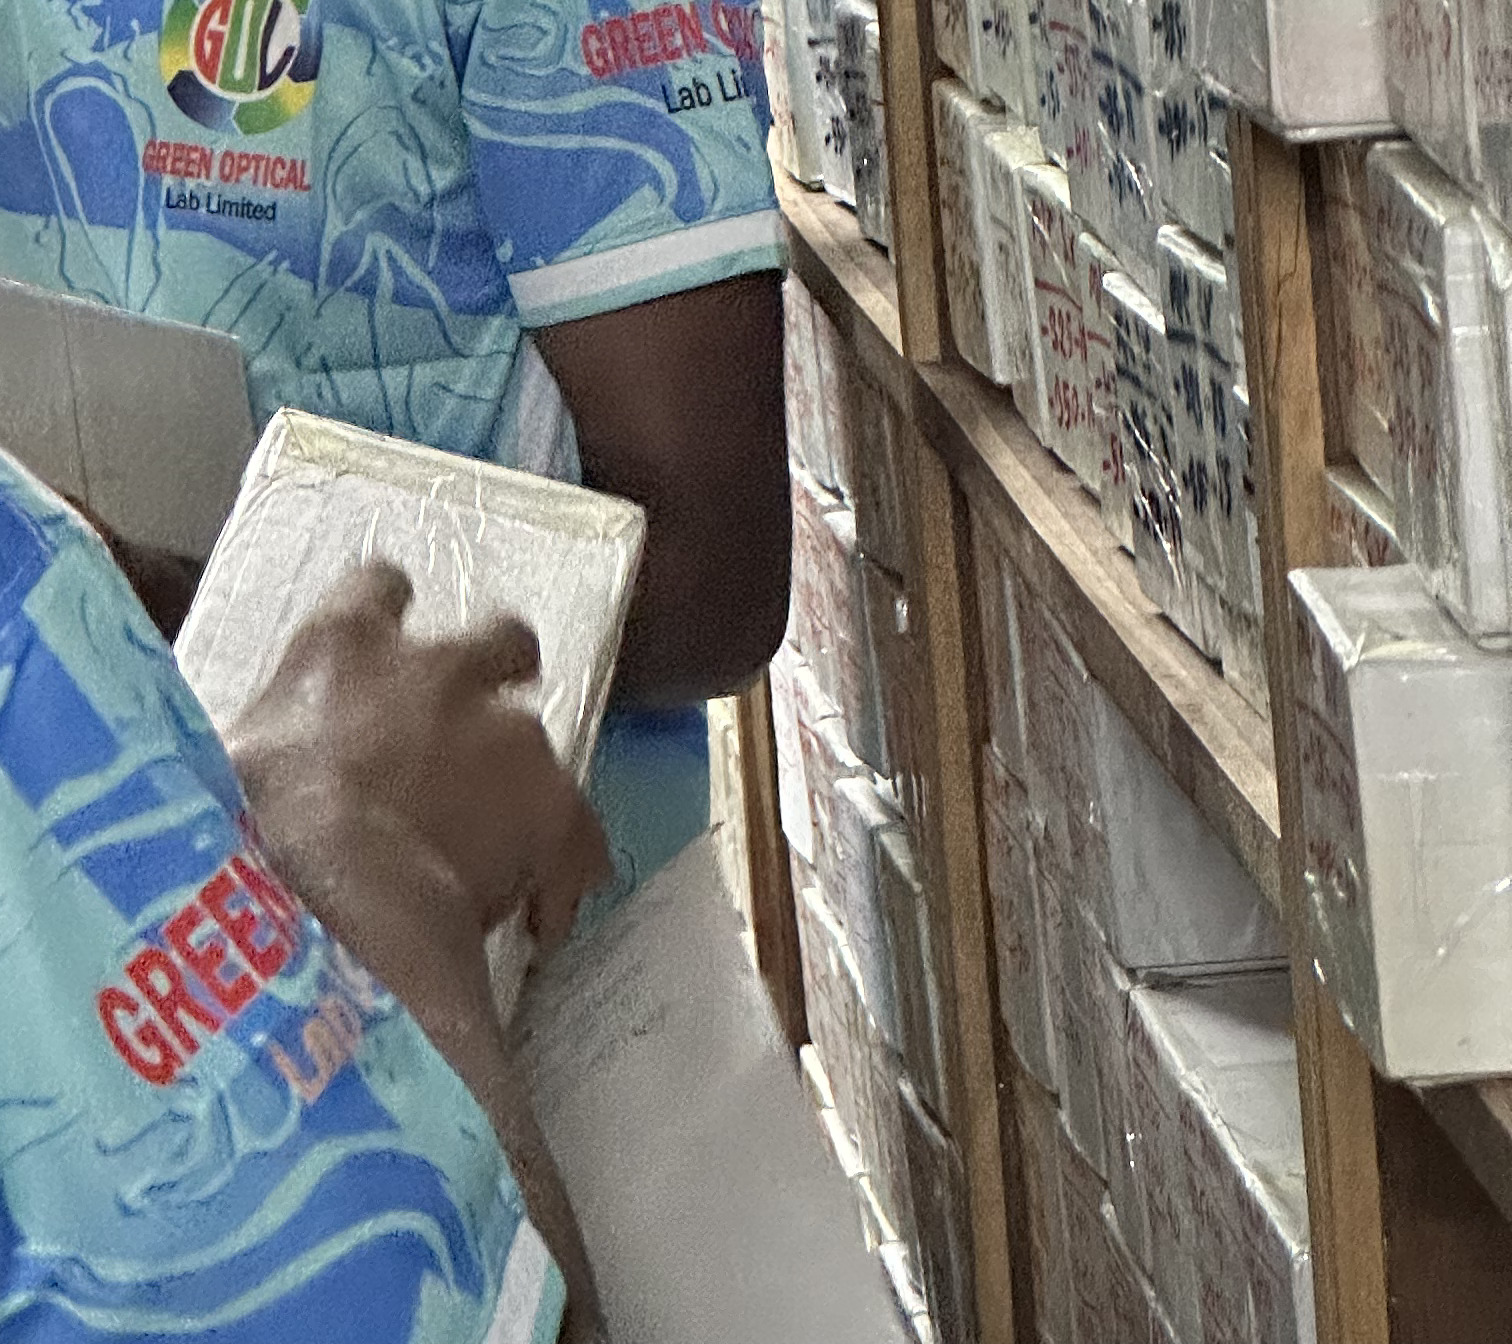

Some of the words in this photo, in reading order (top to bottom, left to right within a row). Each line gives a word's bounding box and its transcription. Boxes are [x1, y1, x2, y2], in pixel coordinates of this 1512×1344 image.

[580, 1, 708, 80] GREEN
[661, 77, 713, 113] Lab
[142, 139, 214, 180] GREEN
[219, 150, 312, 192] OPTICAL
[165, 187, 200, 210] Lab
[206, 192, 277, 222] Limited
